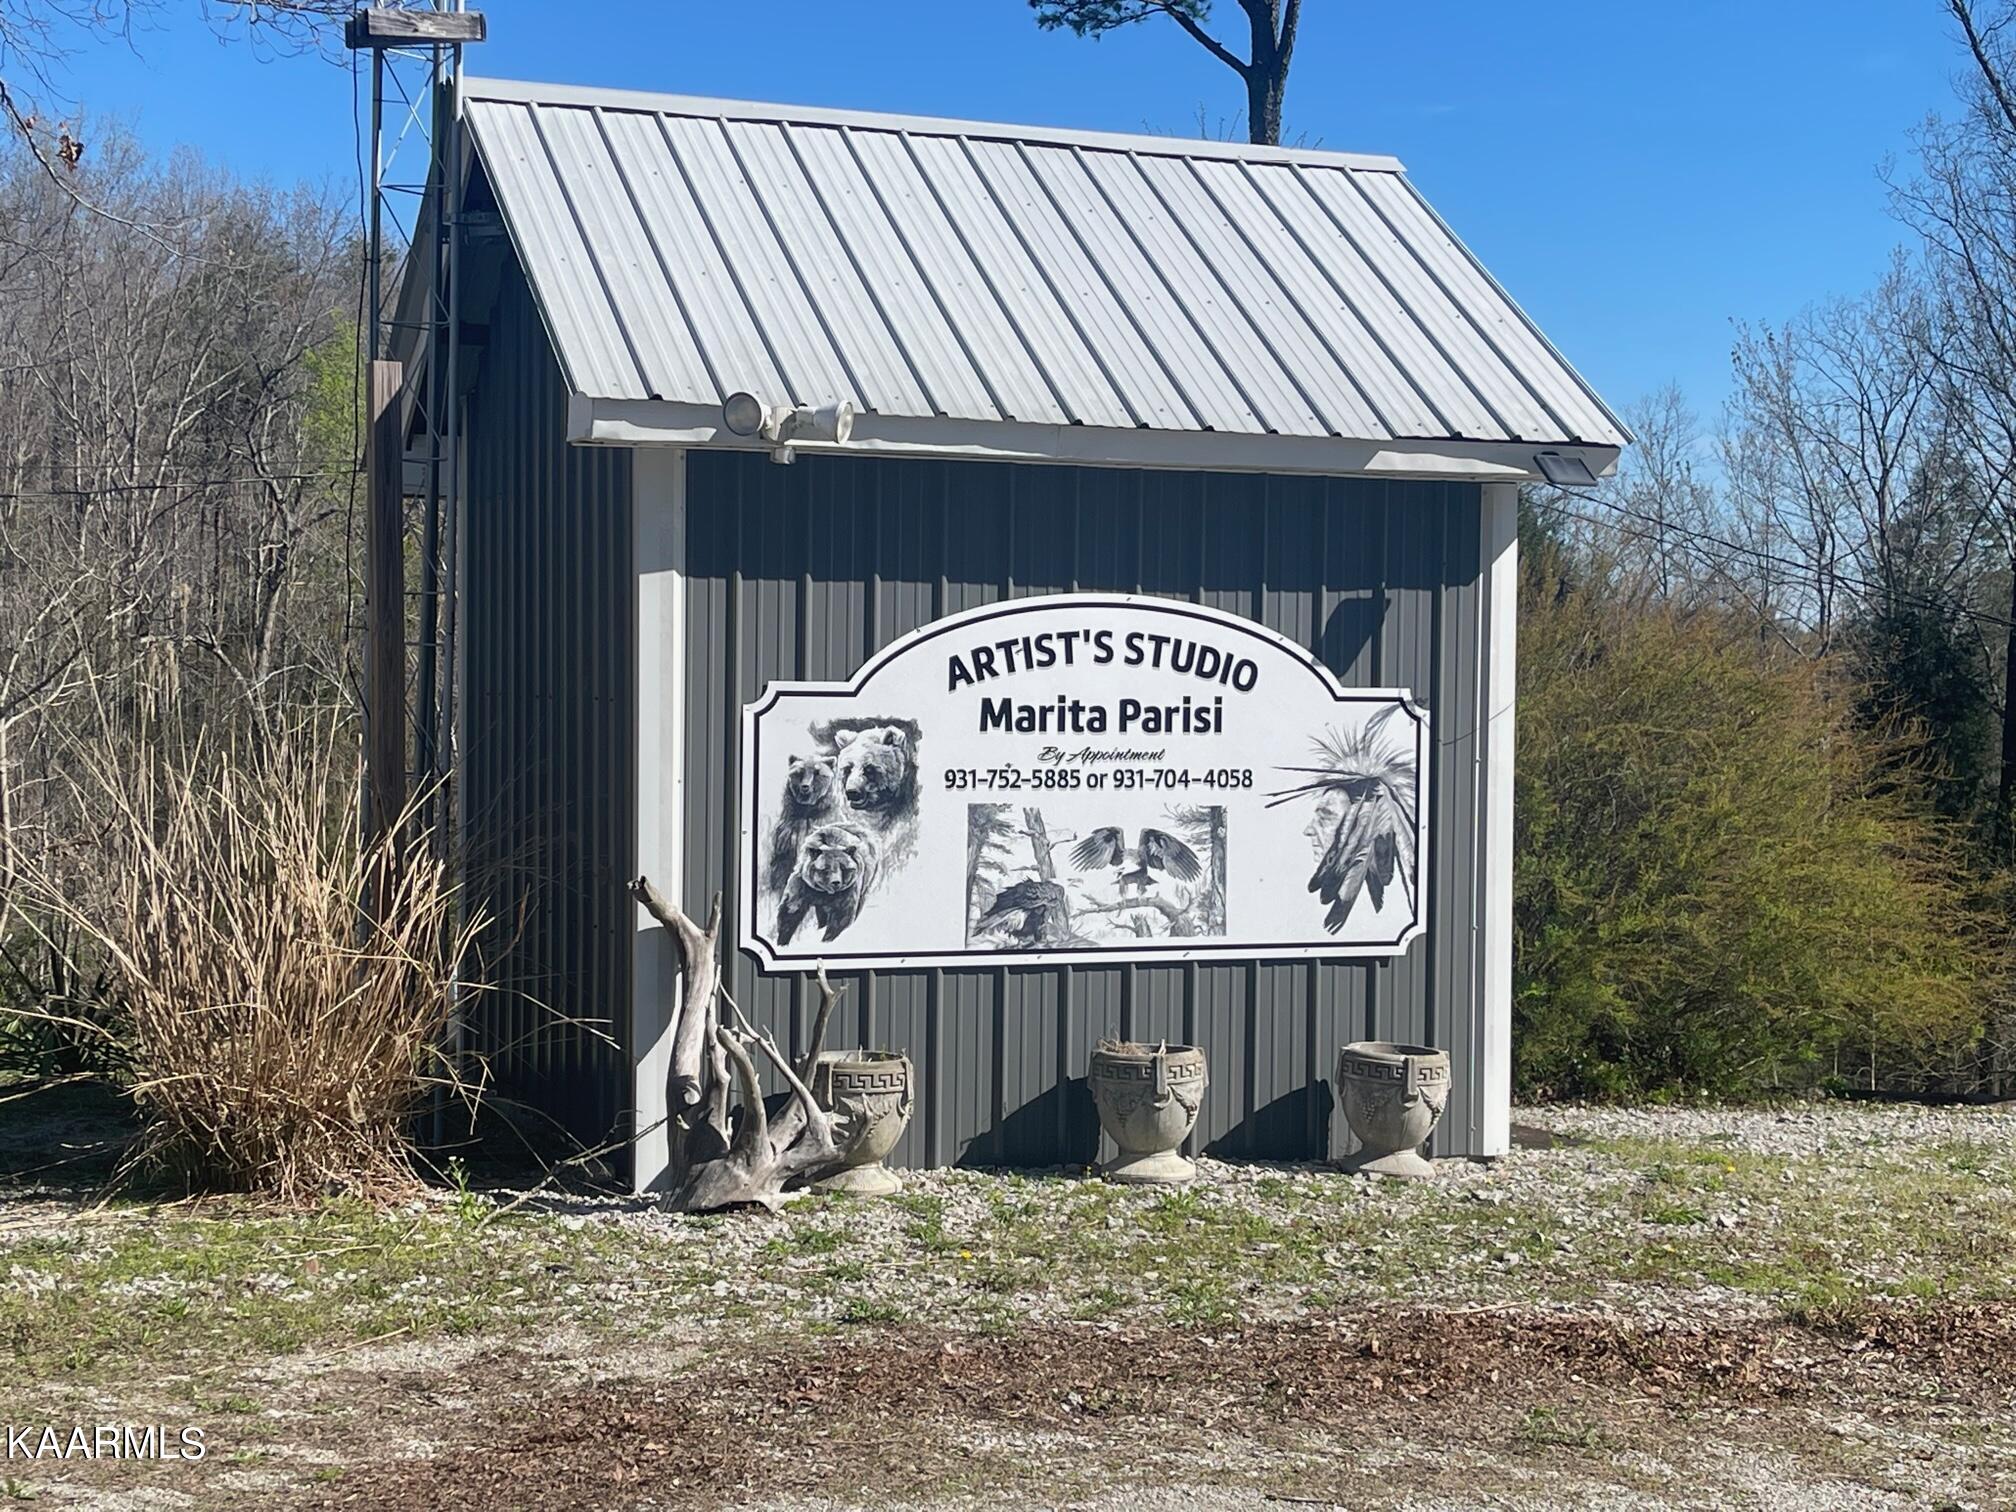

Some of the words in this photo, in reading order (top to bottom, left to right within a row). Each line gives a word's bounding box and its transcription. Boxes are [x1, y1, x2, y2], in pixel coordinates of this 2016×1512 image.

[948, 629, 1114, 692] ARTIST'S
[1124, 632, 1259, 692] STUDIO
[979, 695, 1107, 732] Marita
[1118, 696, 1223, 733] Parisi
[1037, 746, 1065, 766] By
[1066, 746, 1165, 765] Appointment
[944, 769, 1081, 790] 931-752-5885
[1086, 771, 1108, 789] or
[1112, 768, 1253, 789] 931-704-4058
